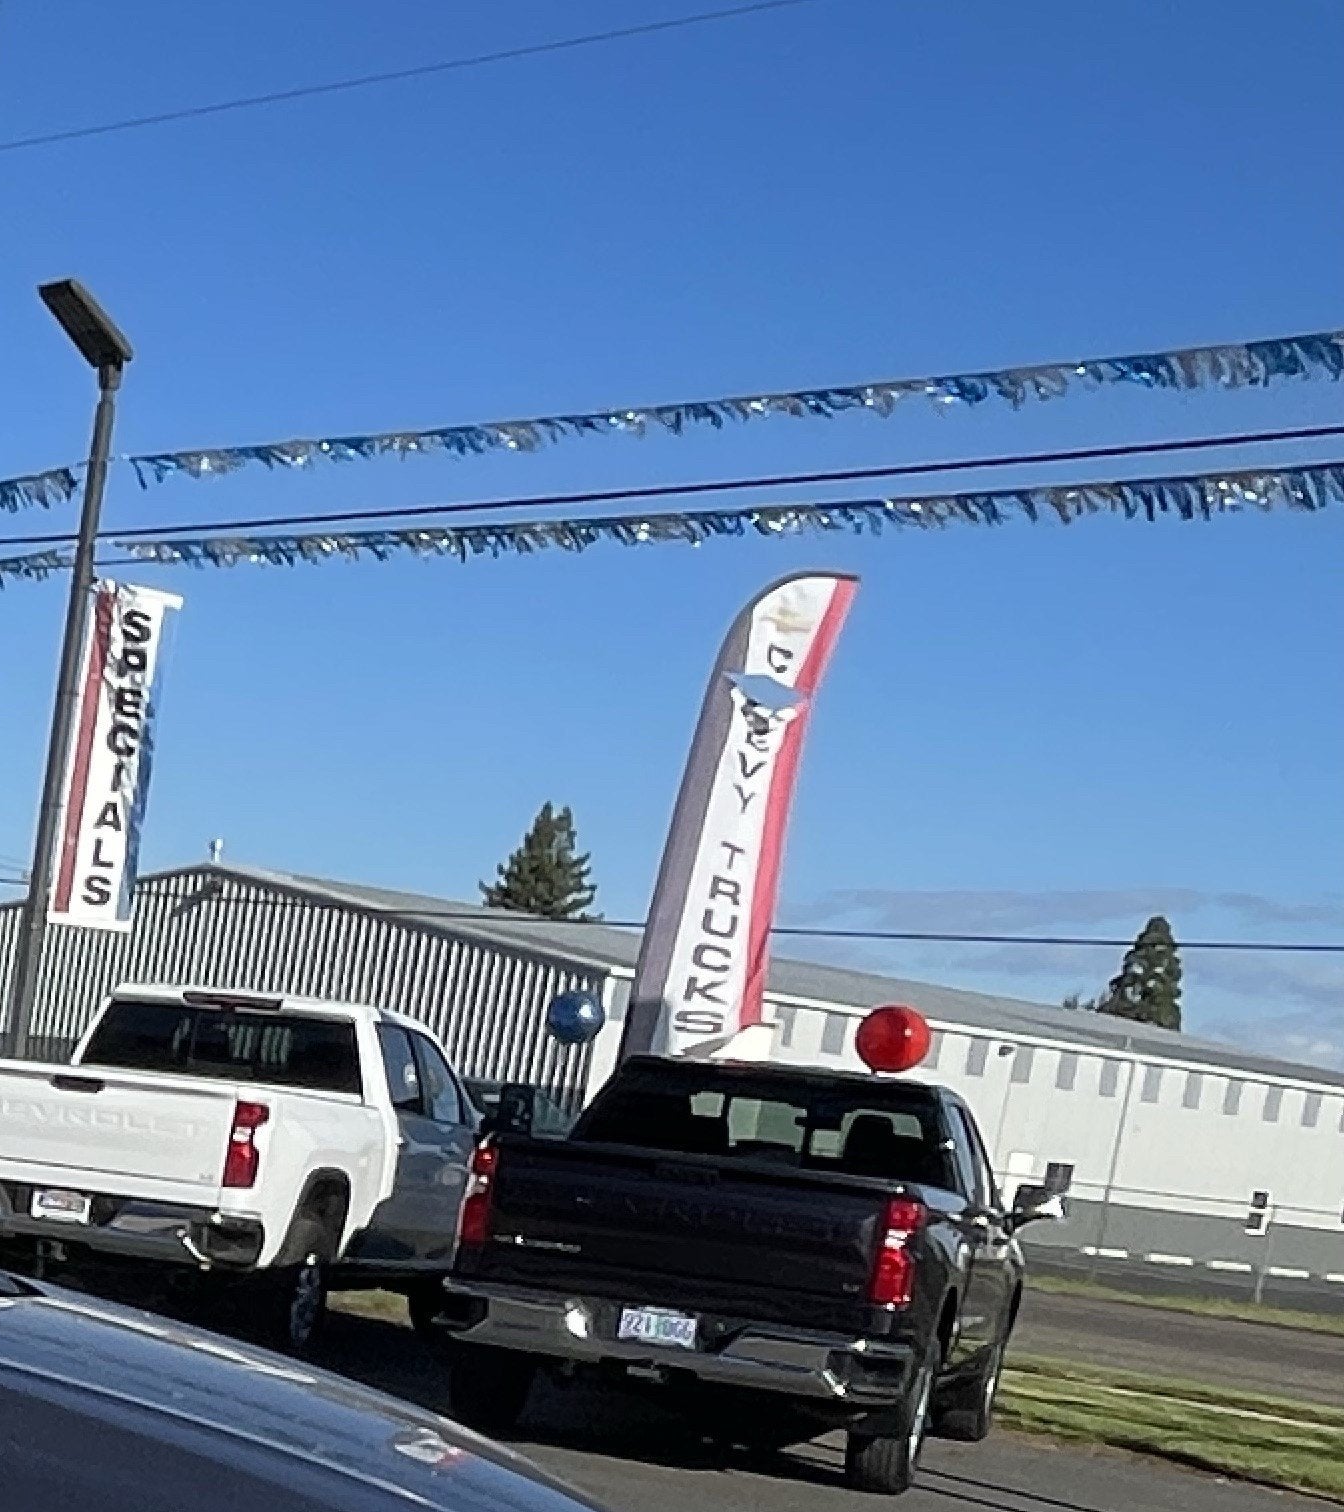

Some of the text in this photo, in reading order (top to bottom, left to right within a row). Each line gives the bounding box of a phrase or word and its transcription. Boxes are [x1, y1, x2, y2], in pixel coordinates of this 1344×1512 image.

[81, 608, 152, 907] SPECIALS
[673, 642, 794, 1034] CEVY TRUCKS
